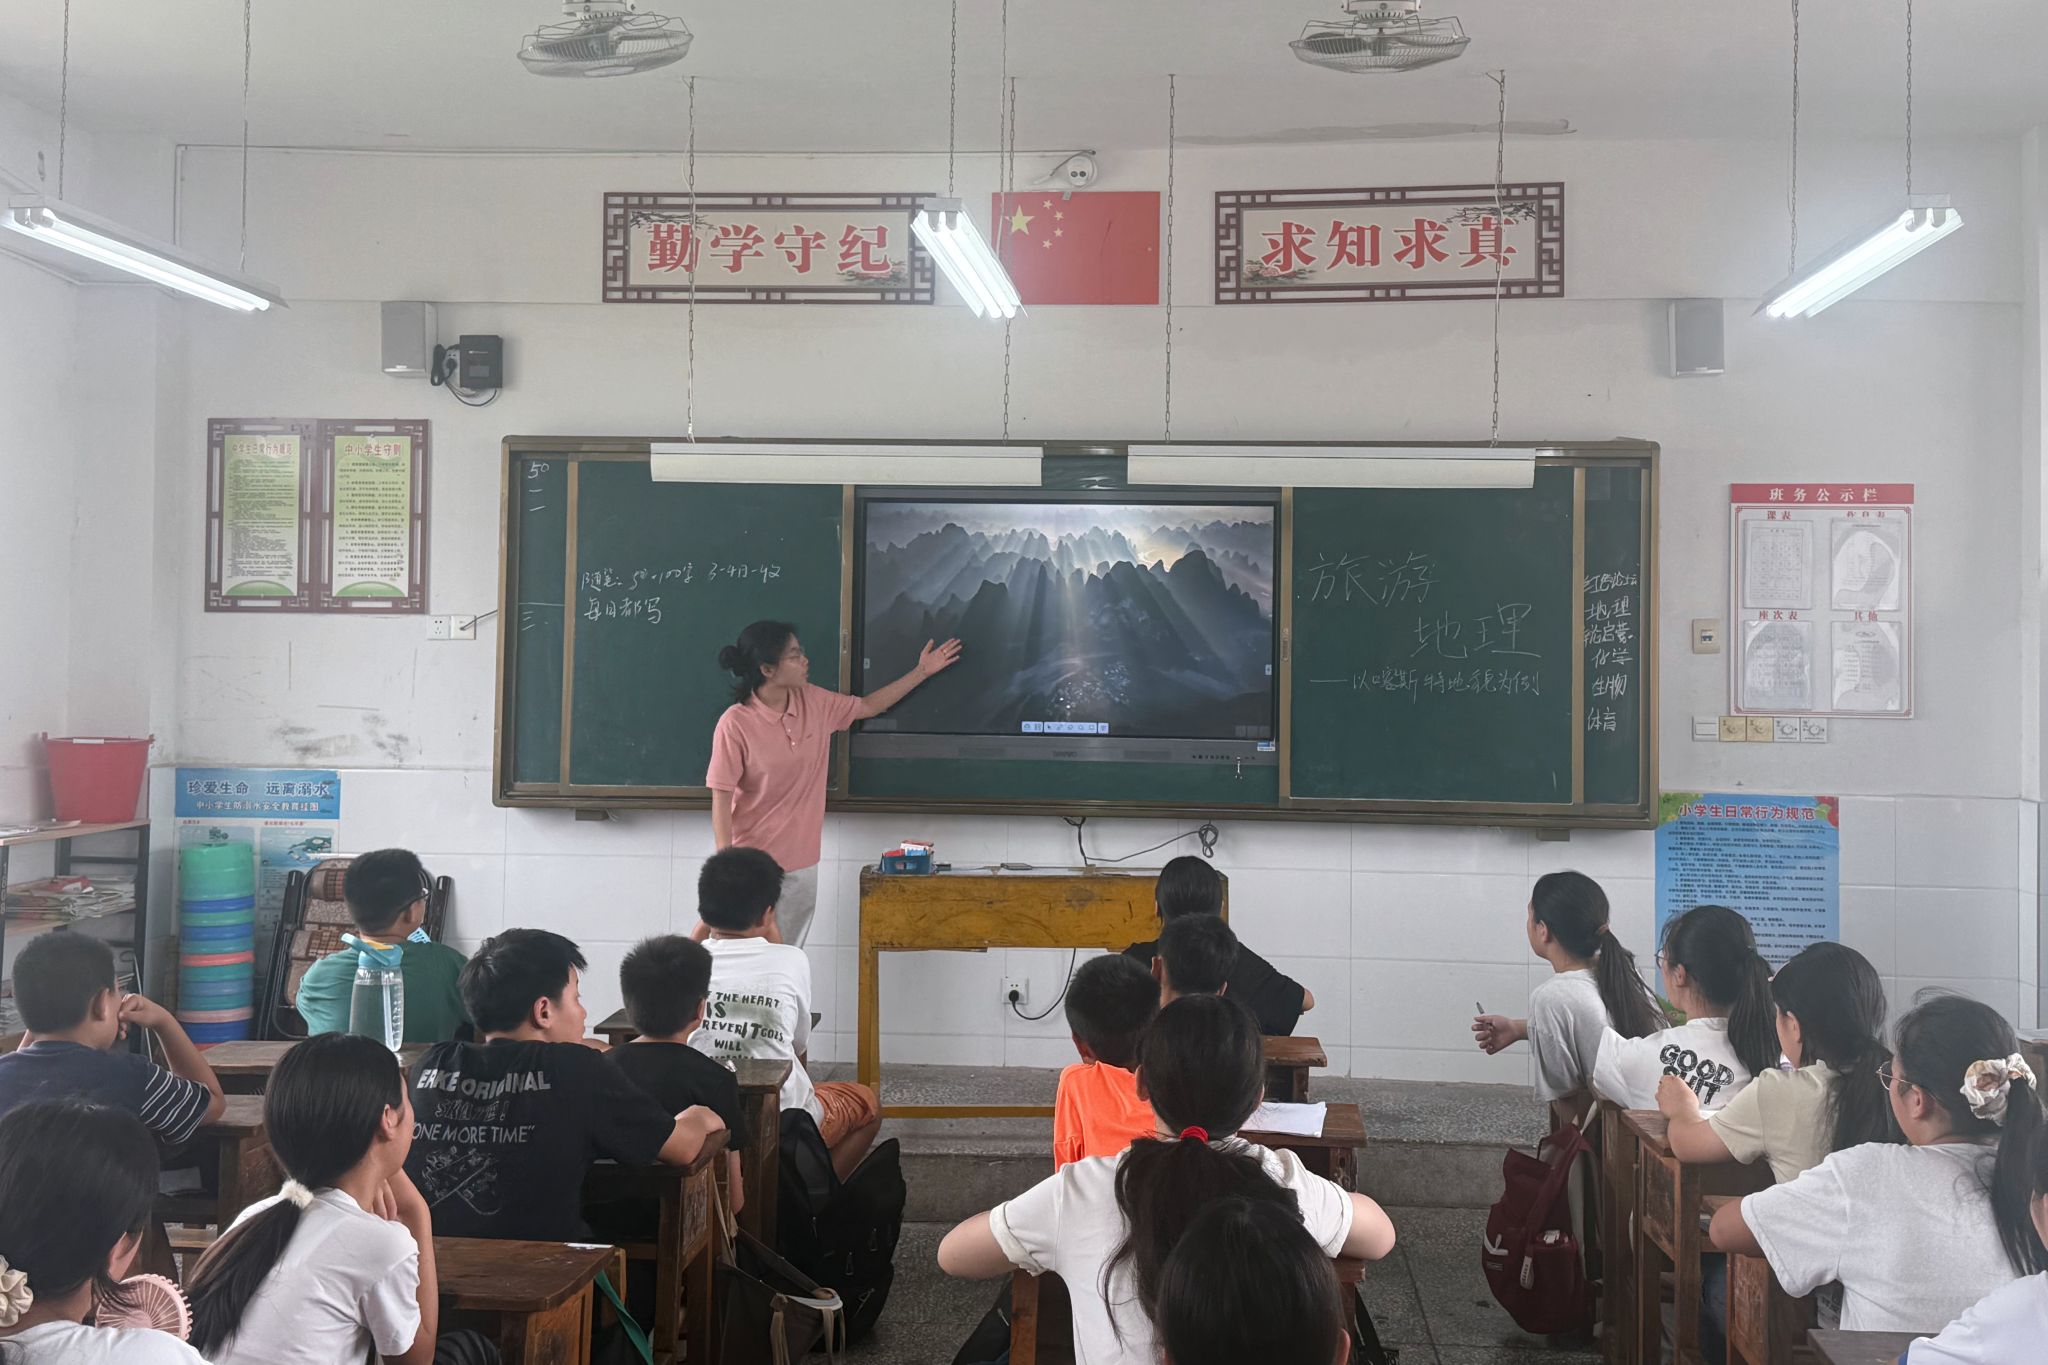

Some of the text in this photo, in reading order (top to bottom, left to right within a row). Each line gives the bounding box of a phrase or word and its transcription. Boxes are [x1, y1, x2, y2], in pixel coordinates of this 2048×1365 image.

[647, 223, 892, 274] 勤学守纪
[1260, 216, 1518, 272] 求知求真
[344, 442, 402, 456] 中小学生守则
[1768, 487, 1878, 503] 班务公示栏
[1766, 510, 1792, 521] 课表
[1308, 551, 1441, 607] 旅游
[1583, 570, 1638, 594] 红色论坛
[1584, 595, 1632, 621] 地理
[1758, 610, 1799, 622] 座次表
[1409, 602, 1542, 659] 地理
[1591, 647, 1633, 669] 化学
[1591, 673, 1628, 701] 生物
[1587, 705, 1617, 732] 体育
[187, 779, 330, 797] 珍爱生命 远离溺水
[1678, 803, 1817, 821] 小学生日常行为规范
[715, 991, 739, 1003] THE
[741, 994, 781, 1009] HEART
[714, 1038, 742, 1052] WILL
[1659, 1043, 1735, 1086] GOOD
[441, 1124, 488, 1144] MORE
